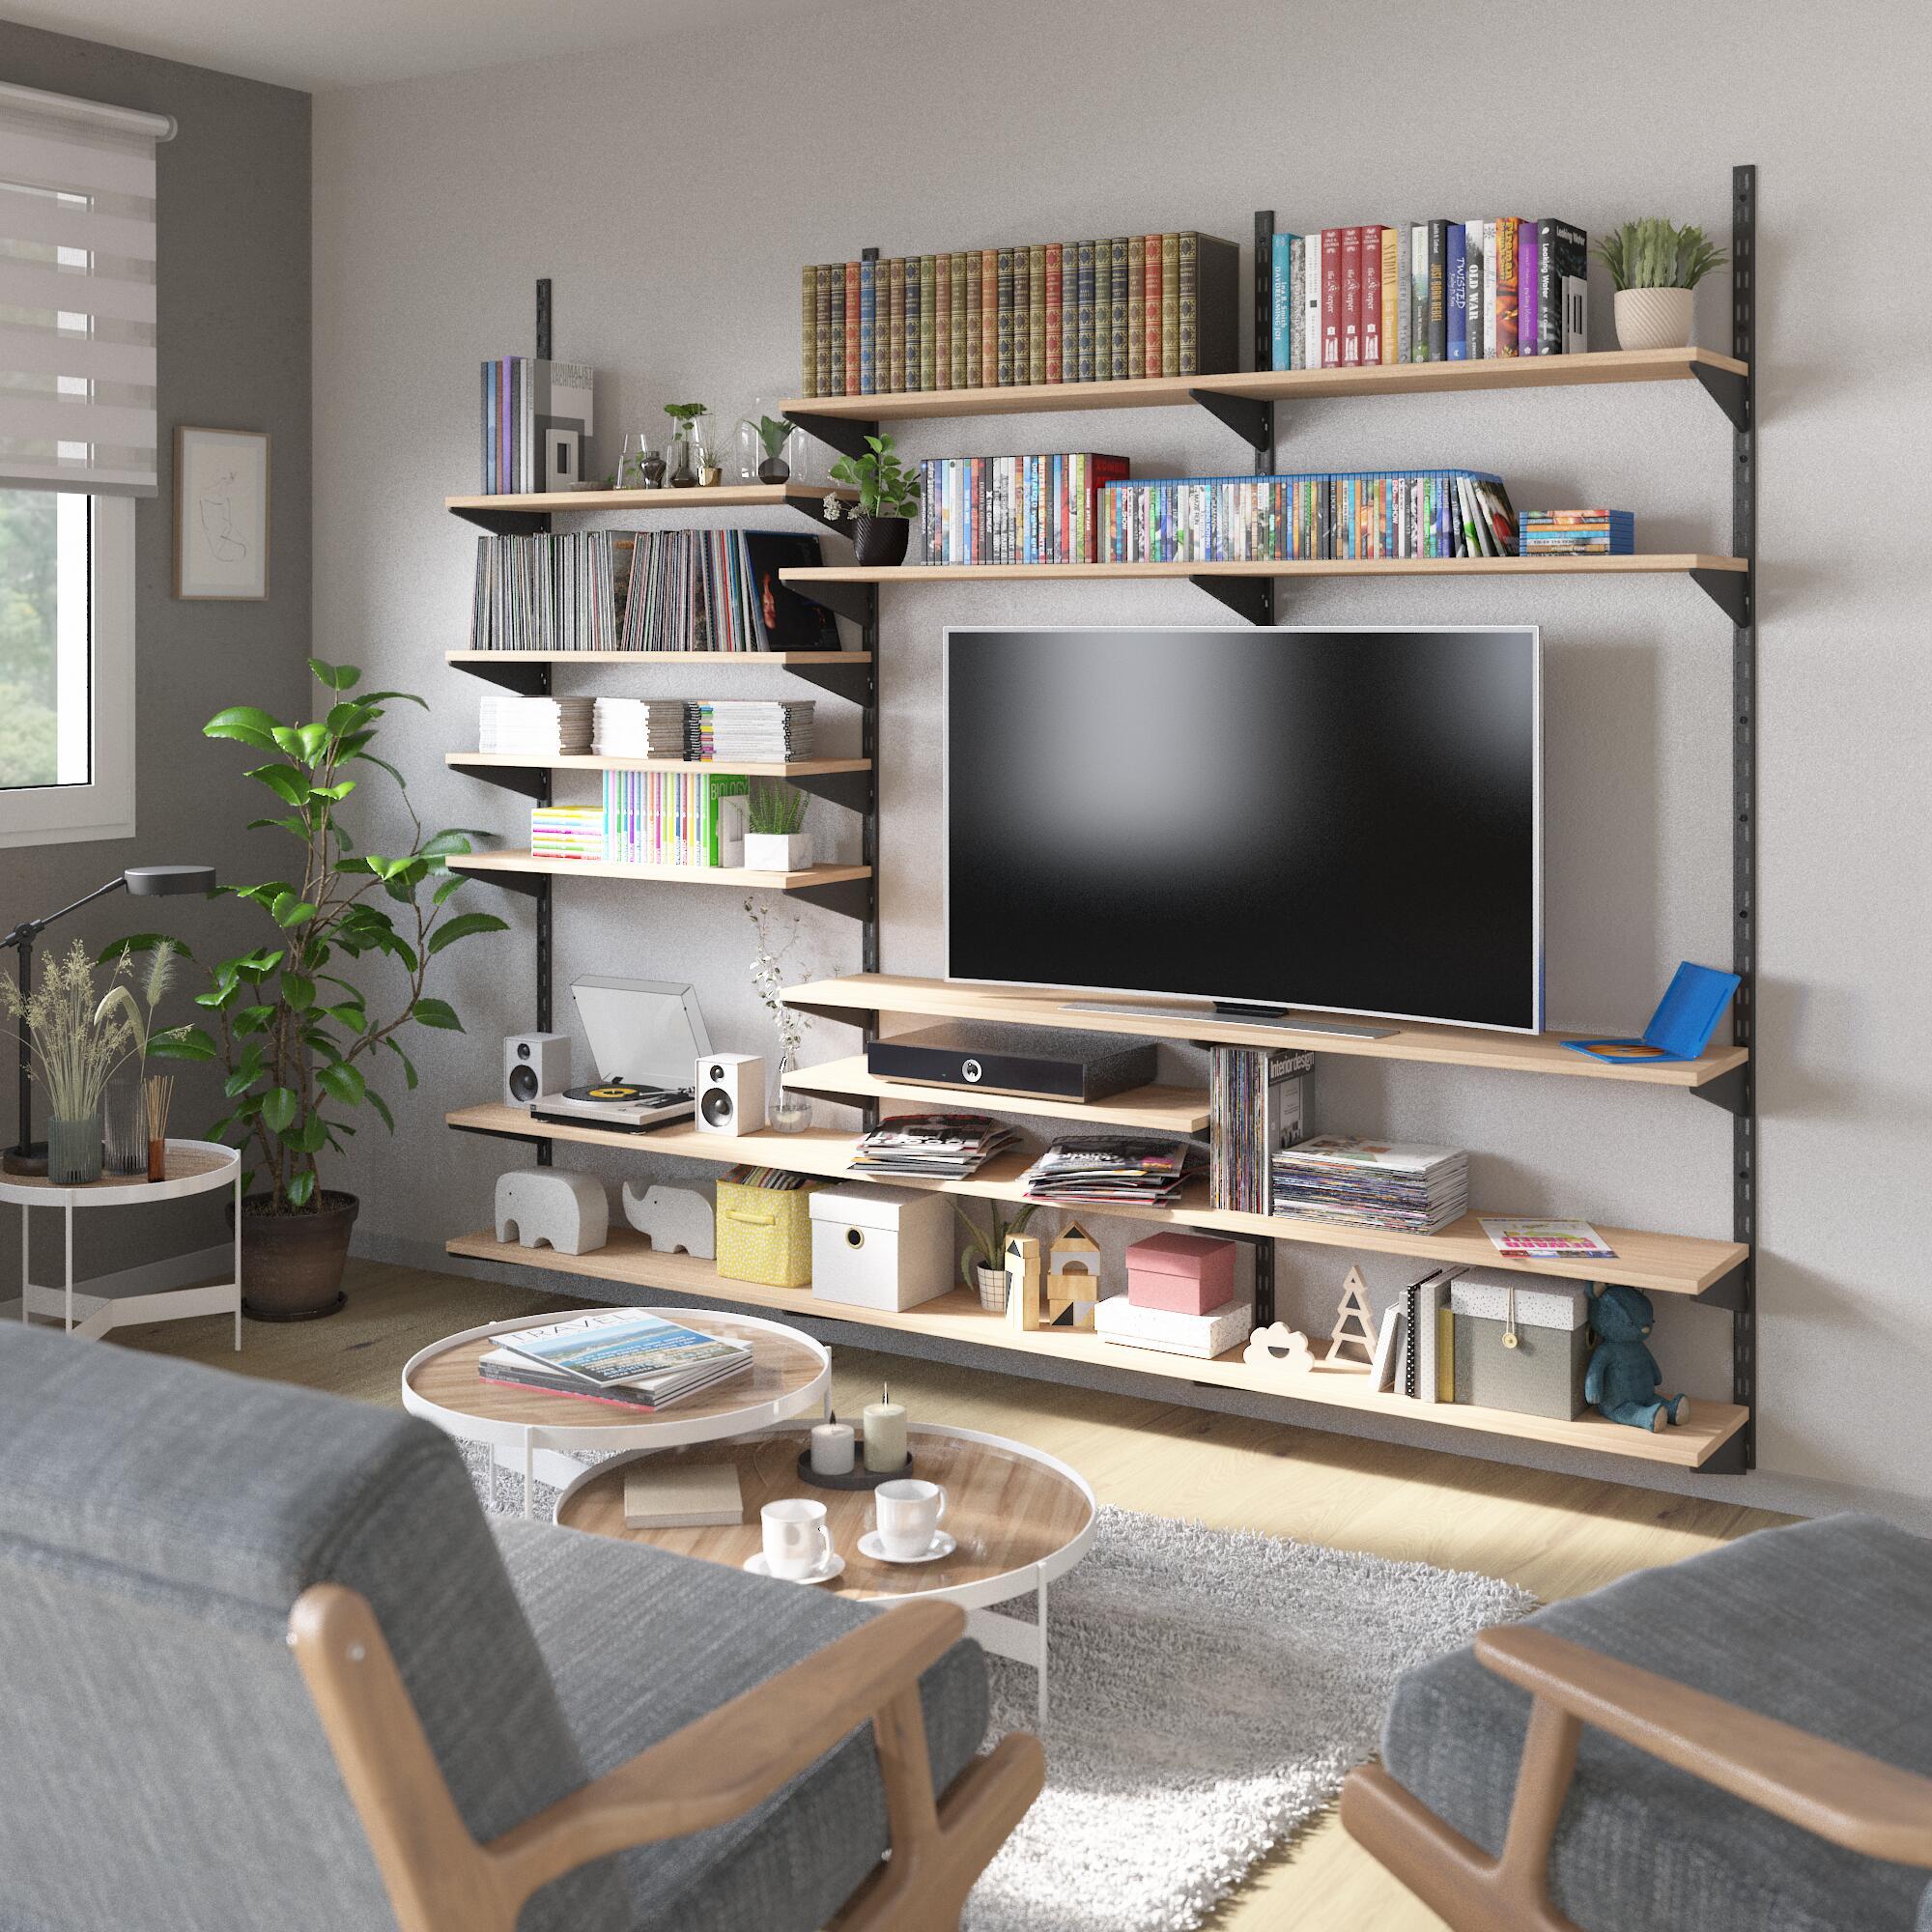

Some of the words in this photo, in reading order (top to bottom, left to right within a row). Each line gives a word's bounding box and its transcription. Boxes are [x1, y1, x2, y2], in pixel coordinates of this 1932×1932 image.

[1382, 243, 1397, 286] SANDMAN
[1541, 242, 1550, 272] Leaking
[1431, 263, 1442, 278] JUST
[1456, 257, 1465, 309] TWISTED
[1468, 264, 1478, 289] OLD
[1431, 280, 1442, 299] BORN
[1542, 274, 1550, 298] Water
[1431, 301, 1442, 323] REBEL
[1468, 292, 1478, 321] WAR
[711, 781, 748, 801] BIOLOGY
[508, 1312, 636, 1344] TRAVEL
